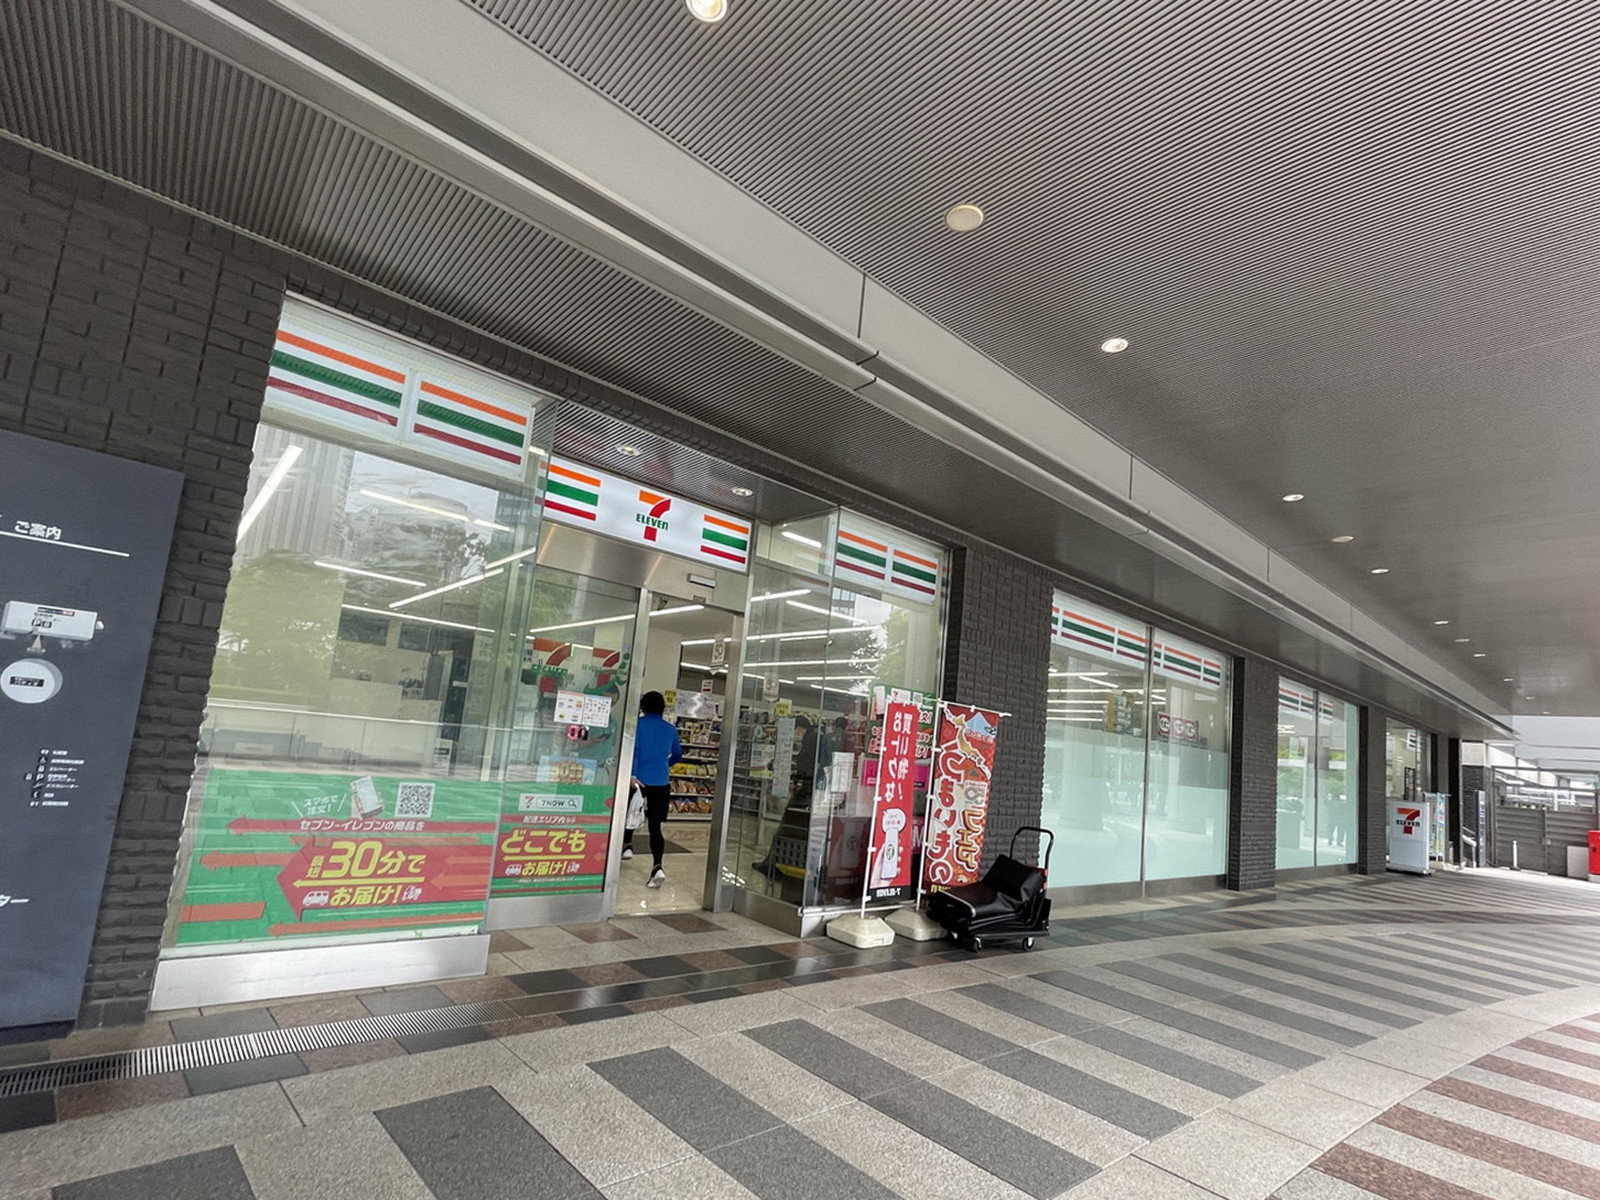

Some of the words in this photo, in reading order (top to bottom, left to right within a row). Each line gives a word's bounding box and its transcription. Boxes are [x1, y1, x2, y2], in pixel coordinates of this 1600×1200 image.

[639, 489, 671, 541] 7
[14, 520, 62, 541] ご案内
[303, 792, 339, 808] スマホで
[306, 804, 332, 817] 注文!
[541, 798, 567, 807] 7NOW
[501, 829, 588, 854] どこでも
[320, 839, 427, 879] 30分で
[522, 860, 568, 876] お届け!
[329, 884, 404, 907] お届け!
